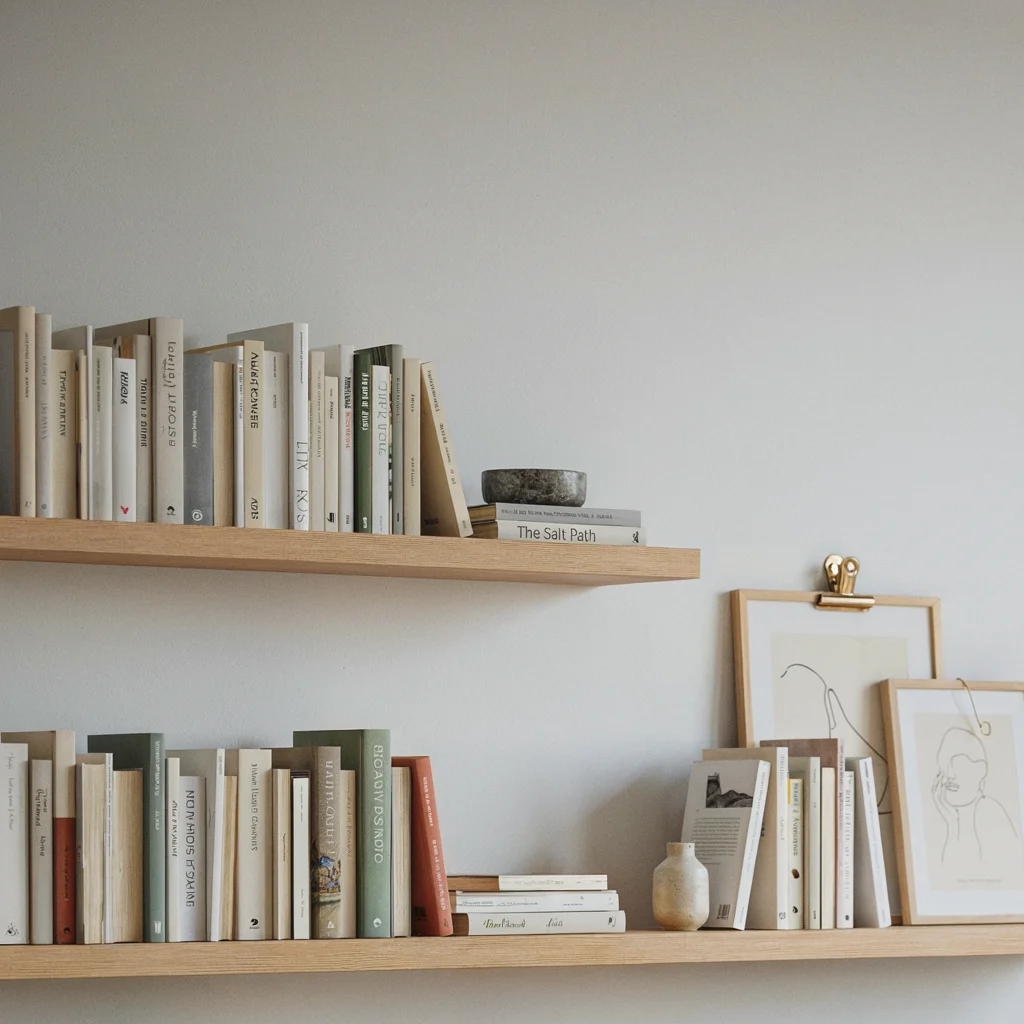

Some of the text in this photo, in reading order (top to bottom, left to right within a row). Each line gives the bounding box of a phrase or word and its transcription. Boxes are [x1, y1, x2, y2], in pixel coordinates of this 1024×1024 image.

[517, 525, 596, 542] The Salt Path
